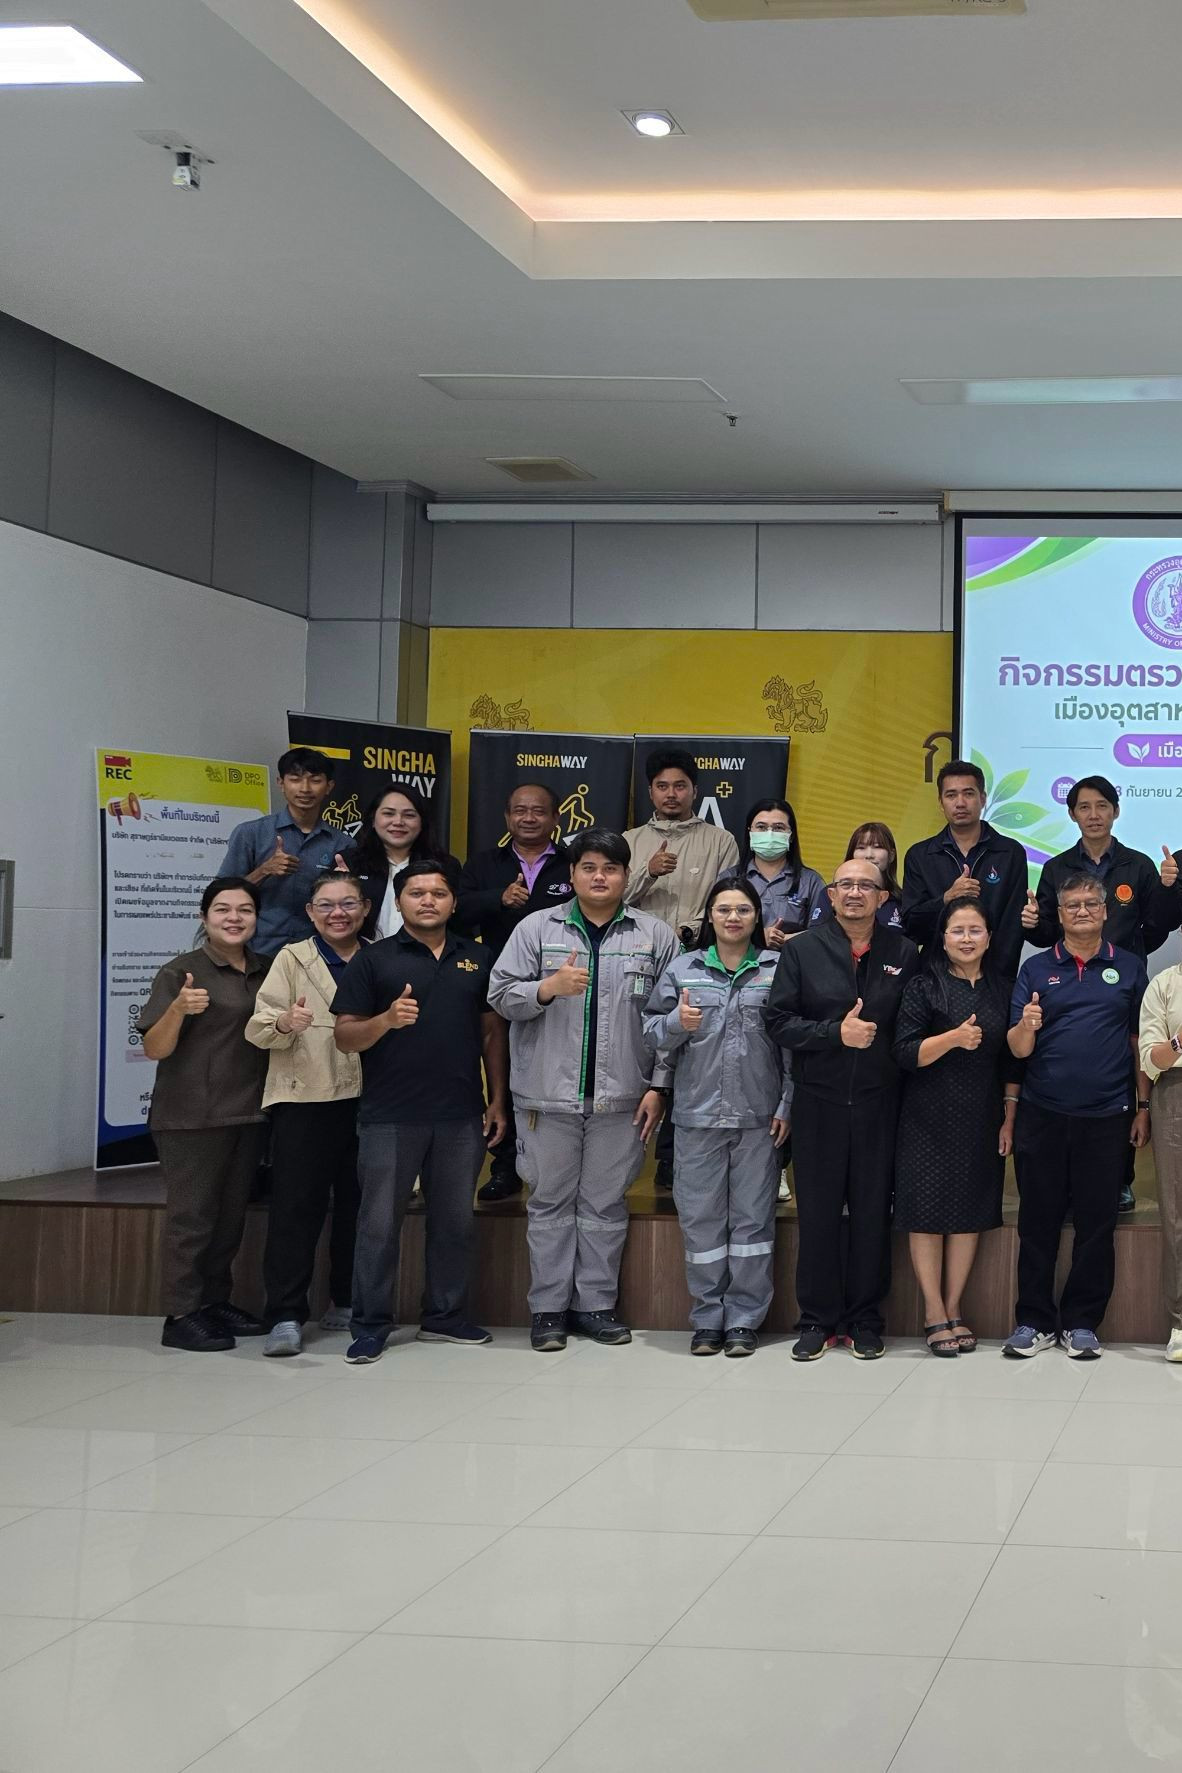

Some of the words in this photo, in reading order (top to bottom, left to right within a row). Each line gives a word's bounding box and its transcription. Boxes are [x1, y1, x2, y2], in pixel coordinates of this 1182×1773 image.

[1142, 622, 1172, 646] MINISTRY
[363, 746, 436, 775] SINGHA
[516, 753, 588, 769] SINGHAWAY
[694, 756, 746, 771] GHAWAY
[105, 767, 133, 780] REC
[245, 772, 261, 780] DPO
[244, 779, 264, 787] Office
[1126, 785, 1172, 798] กันยายน
